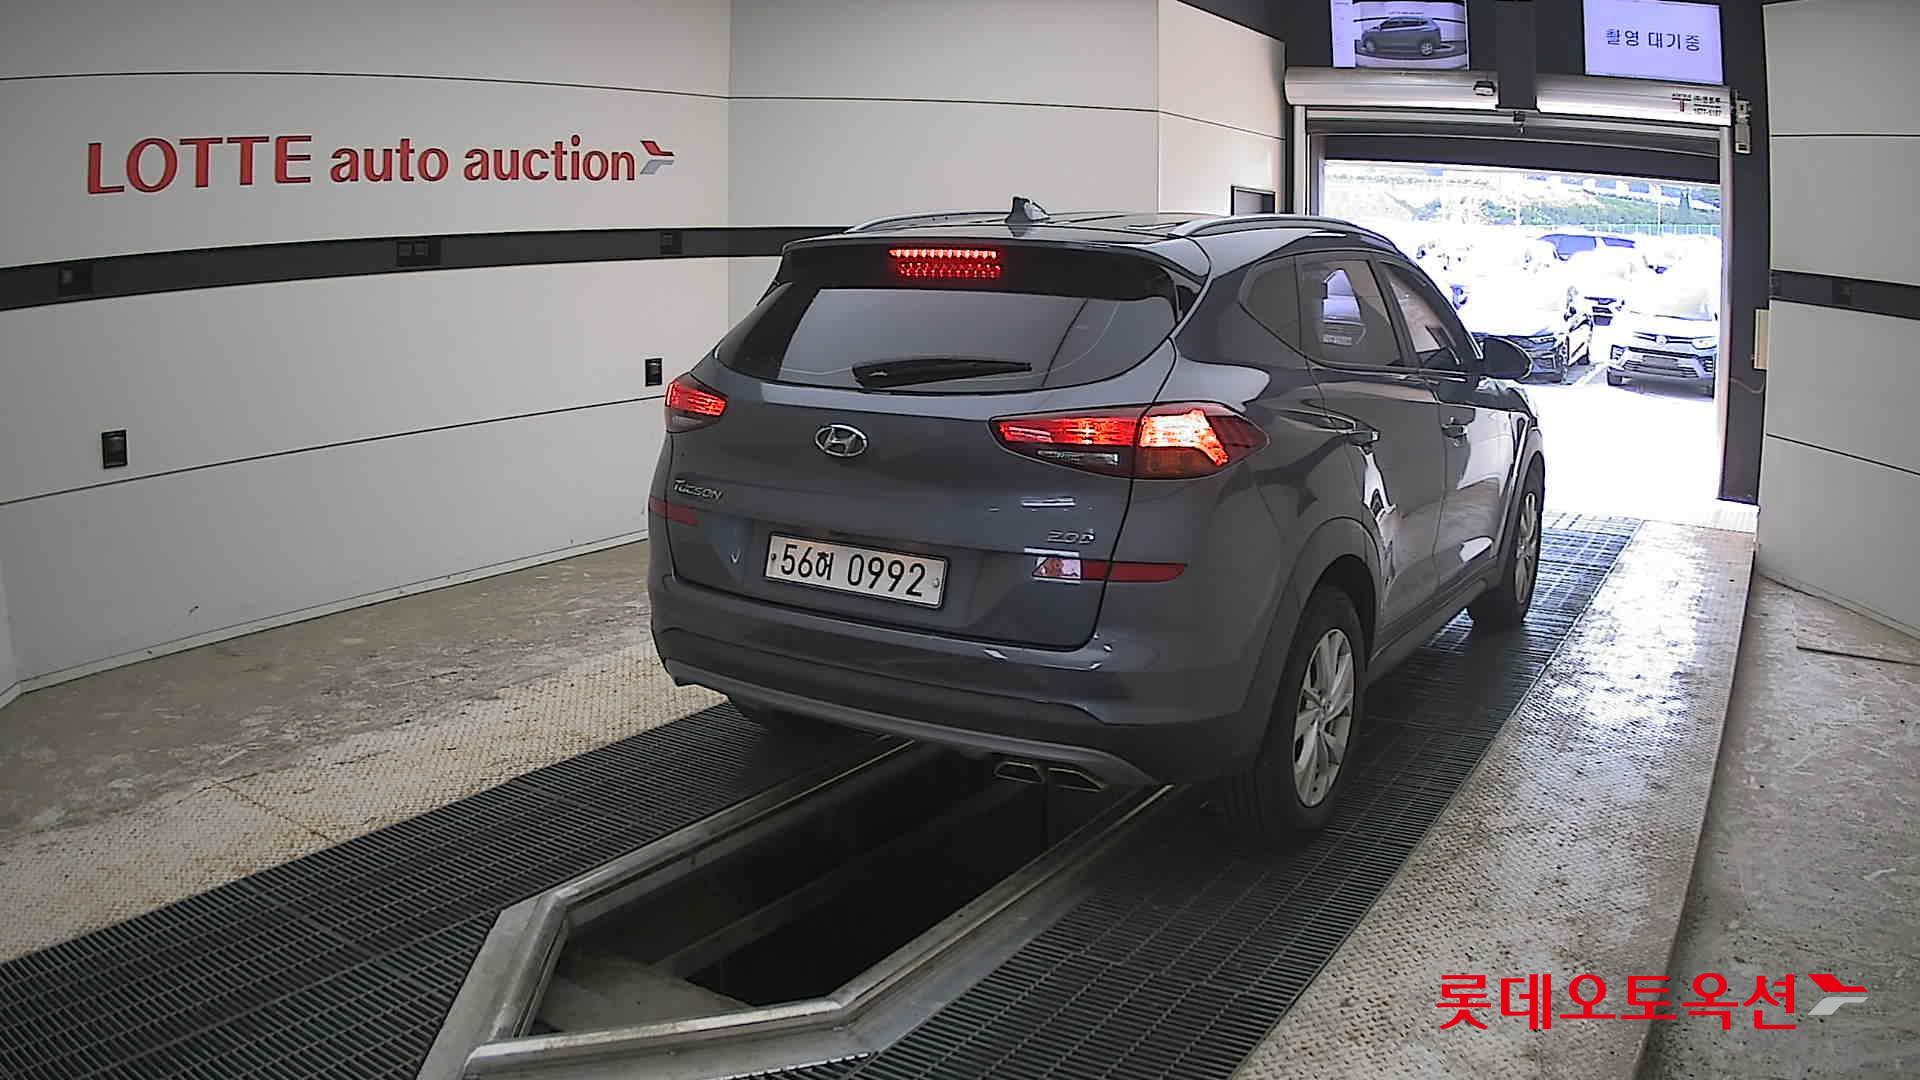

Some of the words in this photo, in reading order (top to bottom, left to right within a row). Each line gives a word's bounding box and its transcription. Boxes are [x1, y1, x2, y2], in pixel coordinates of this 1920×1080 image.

[87, 134, 312, 195] LOTTE
[329, 138, 449, 183] auto
[463, 134, 637, 182] auction
[780, 543, 834, 581] 56허
[847, 554, 926, 597] 0992
